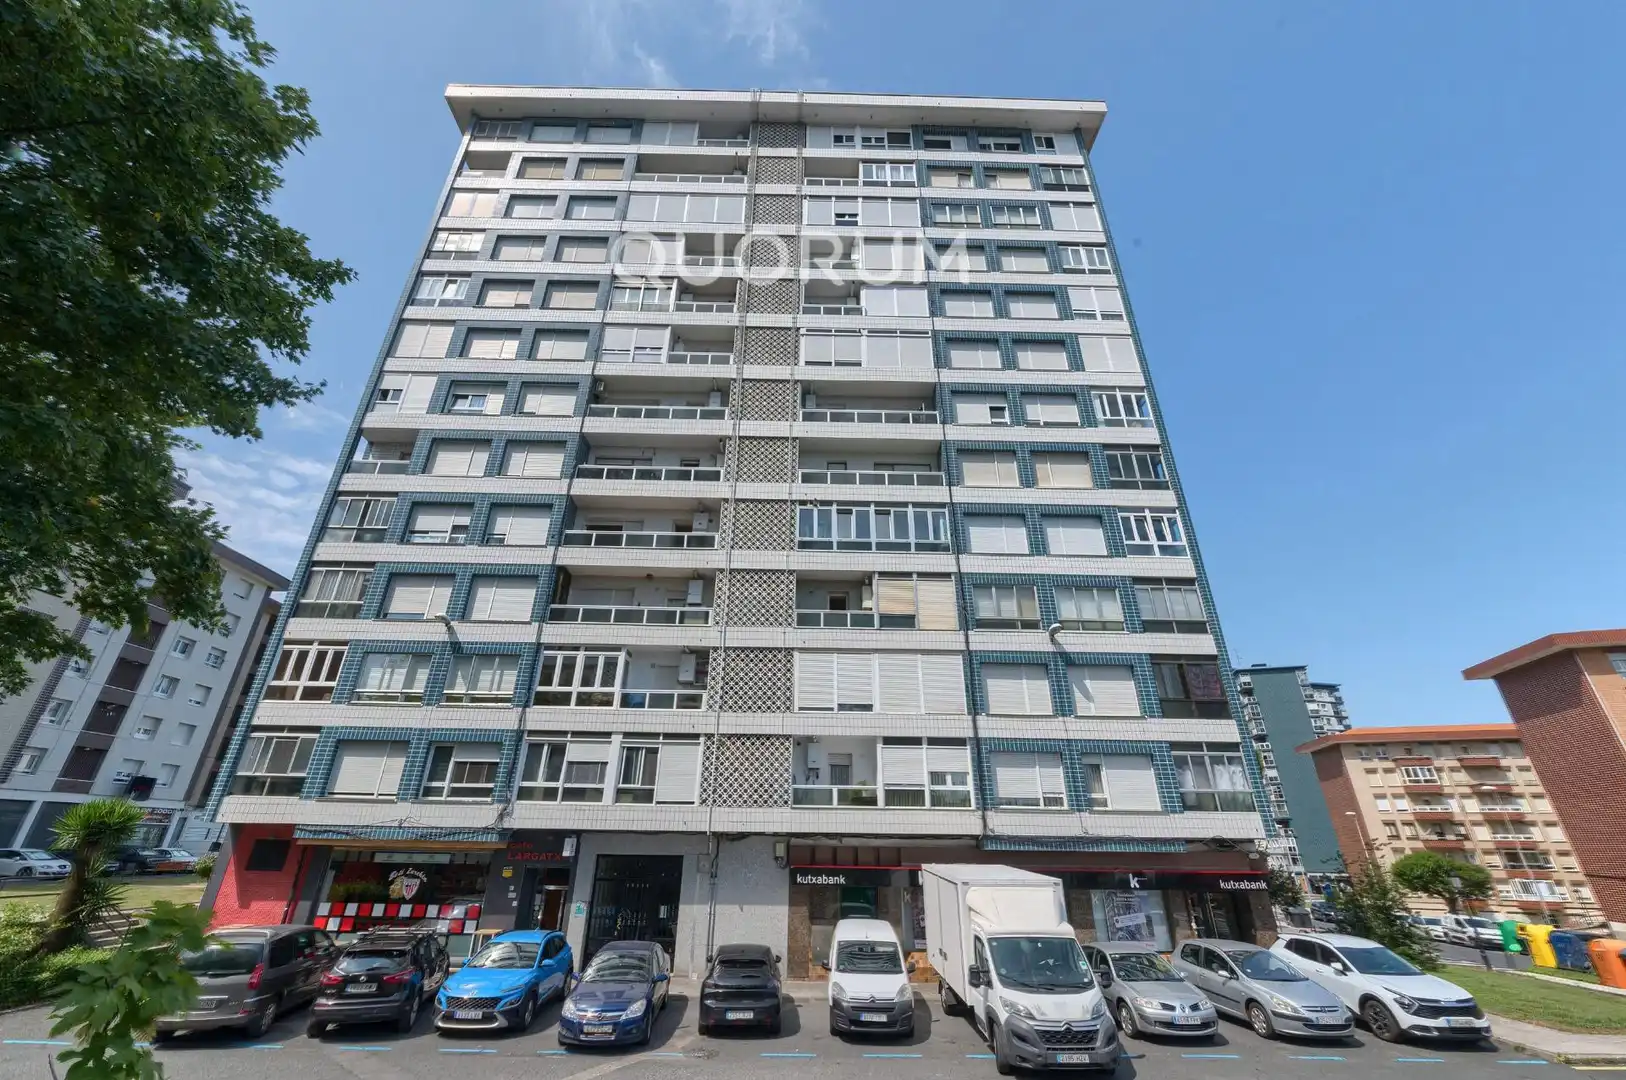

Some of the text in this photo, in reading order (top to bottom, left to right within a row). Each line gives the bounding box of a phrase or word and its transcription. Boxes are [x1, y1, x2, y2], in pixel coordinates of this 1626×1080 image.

[507, 851, 569, 861] LARGATX
[796, 873, 846, 884] kutxabank
[1219, 879, 1269, 890] kutxabank
